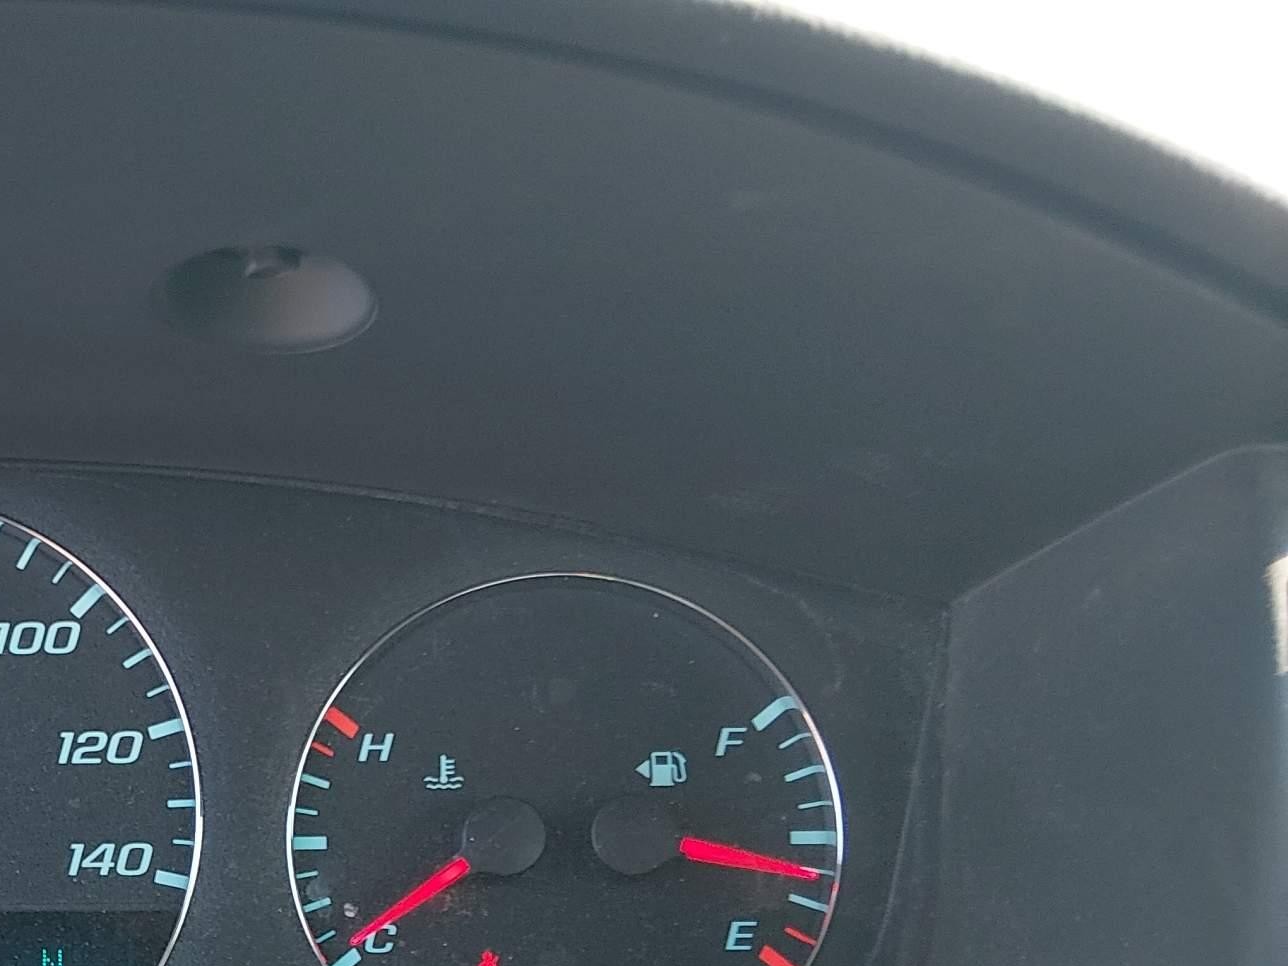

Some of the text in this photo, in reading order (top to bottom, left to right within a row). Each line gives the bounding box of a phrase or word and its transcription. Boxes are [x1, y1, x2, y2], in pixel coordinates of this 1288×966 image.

[57, 730, 144, 765] 120
[357, 733, 394, 762] H
[715, 727, 749, 757] F
[67, 843, 153, 877] 140
[364, 923, 396, 955] C
[724, 921, 758, 951] E
